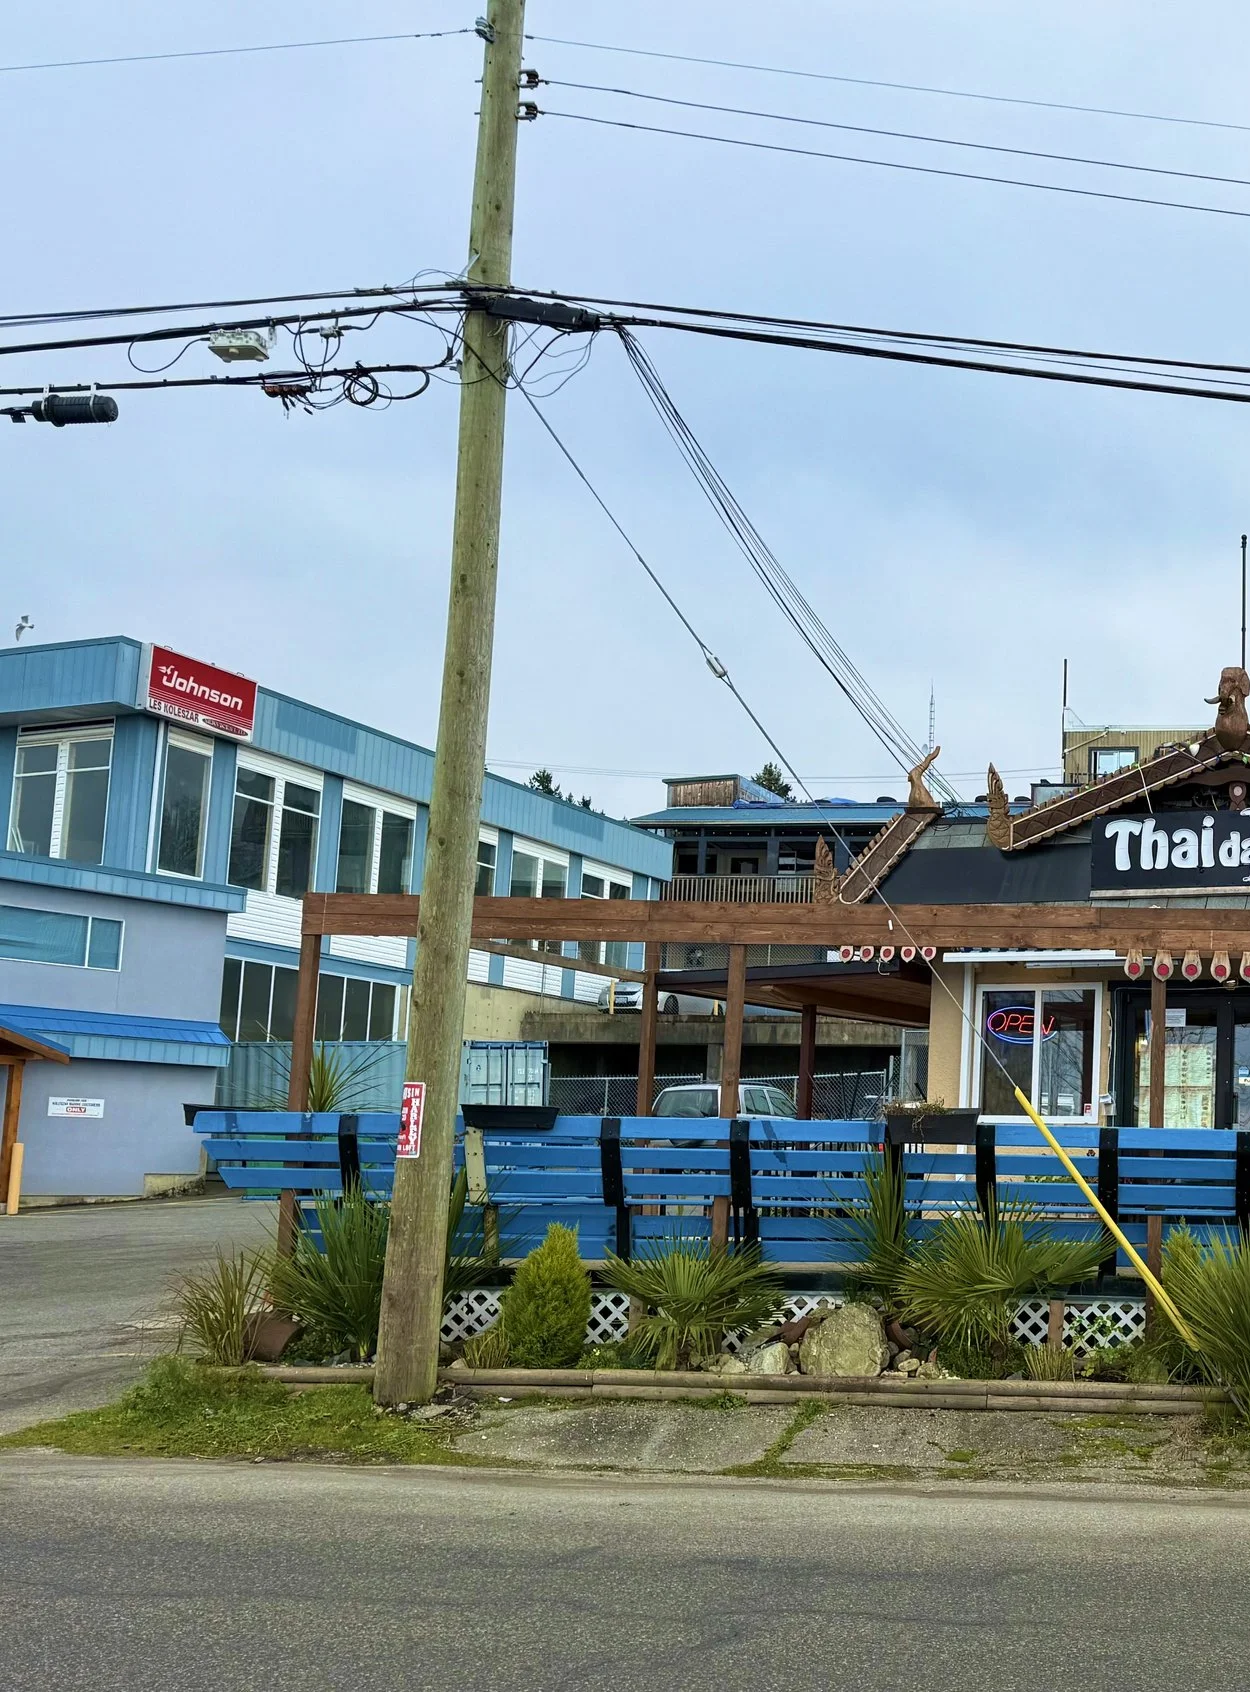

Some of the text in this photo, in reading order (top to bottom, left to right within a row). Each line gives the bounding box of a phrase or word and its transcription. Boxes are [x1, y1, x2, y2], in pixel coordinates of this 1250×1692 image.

[162, 670, 243, 711] Johnson
[149, 698, 199, 724] LES KOLESZAR
[990, 1012, 1055, 1035] OPEN
